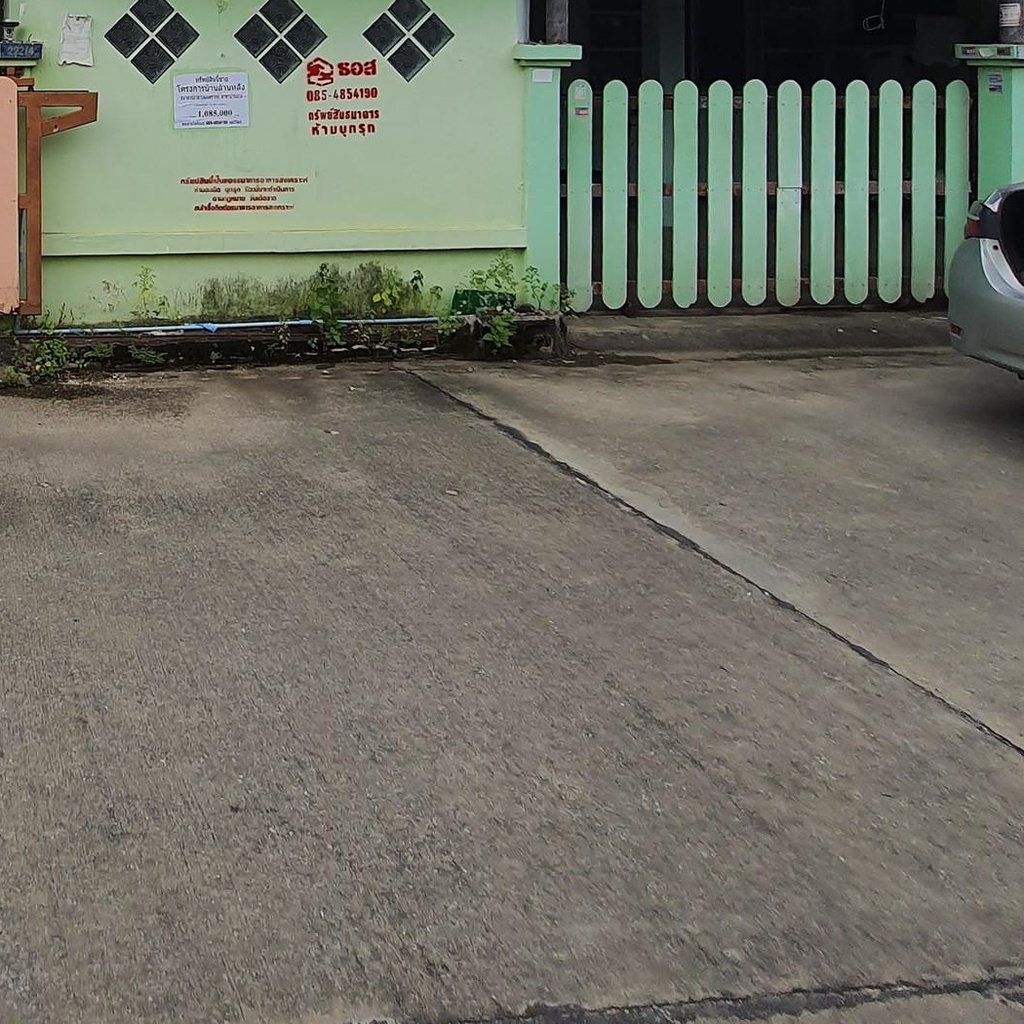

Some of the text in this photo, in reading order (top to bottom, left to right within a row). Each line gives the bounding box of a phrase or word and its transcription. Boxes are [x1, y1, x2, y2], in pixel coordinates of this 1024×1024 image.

[337, 59, 377, 76] ธอส
[306, 87, 378, 102] 085-4854190
[311, 123, 375, 137] ห้ามบุกรุก
